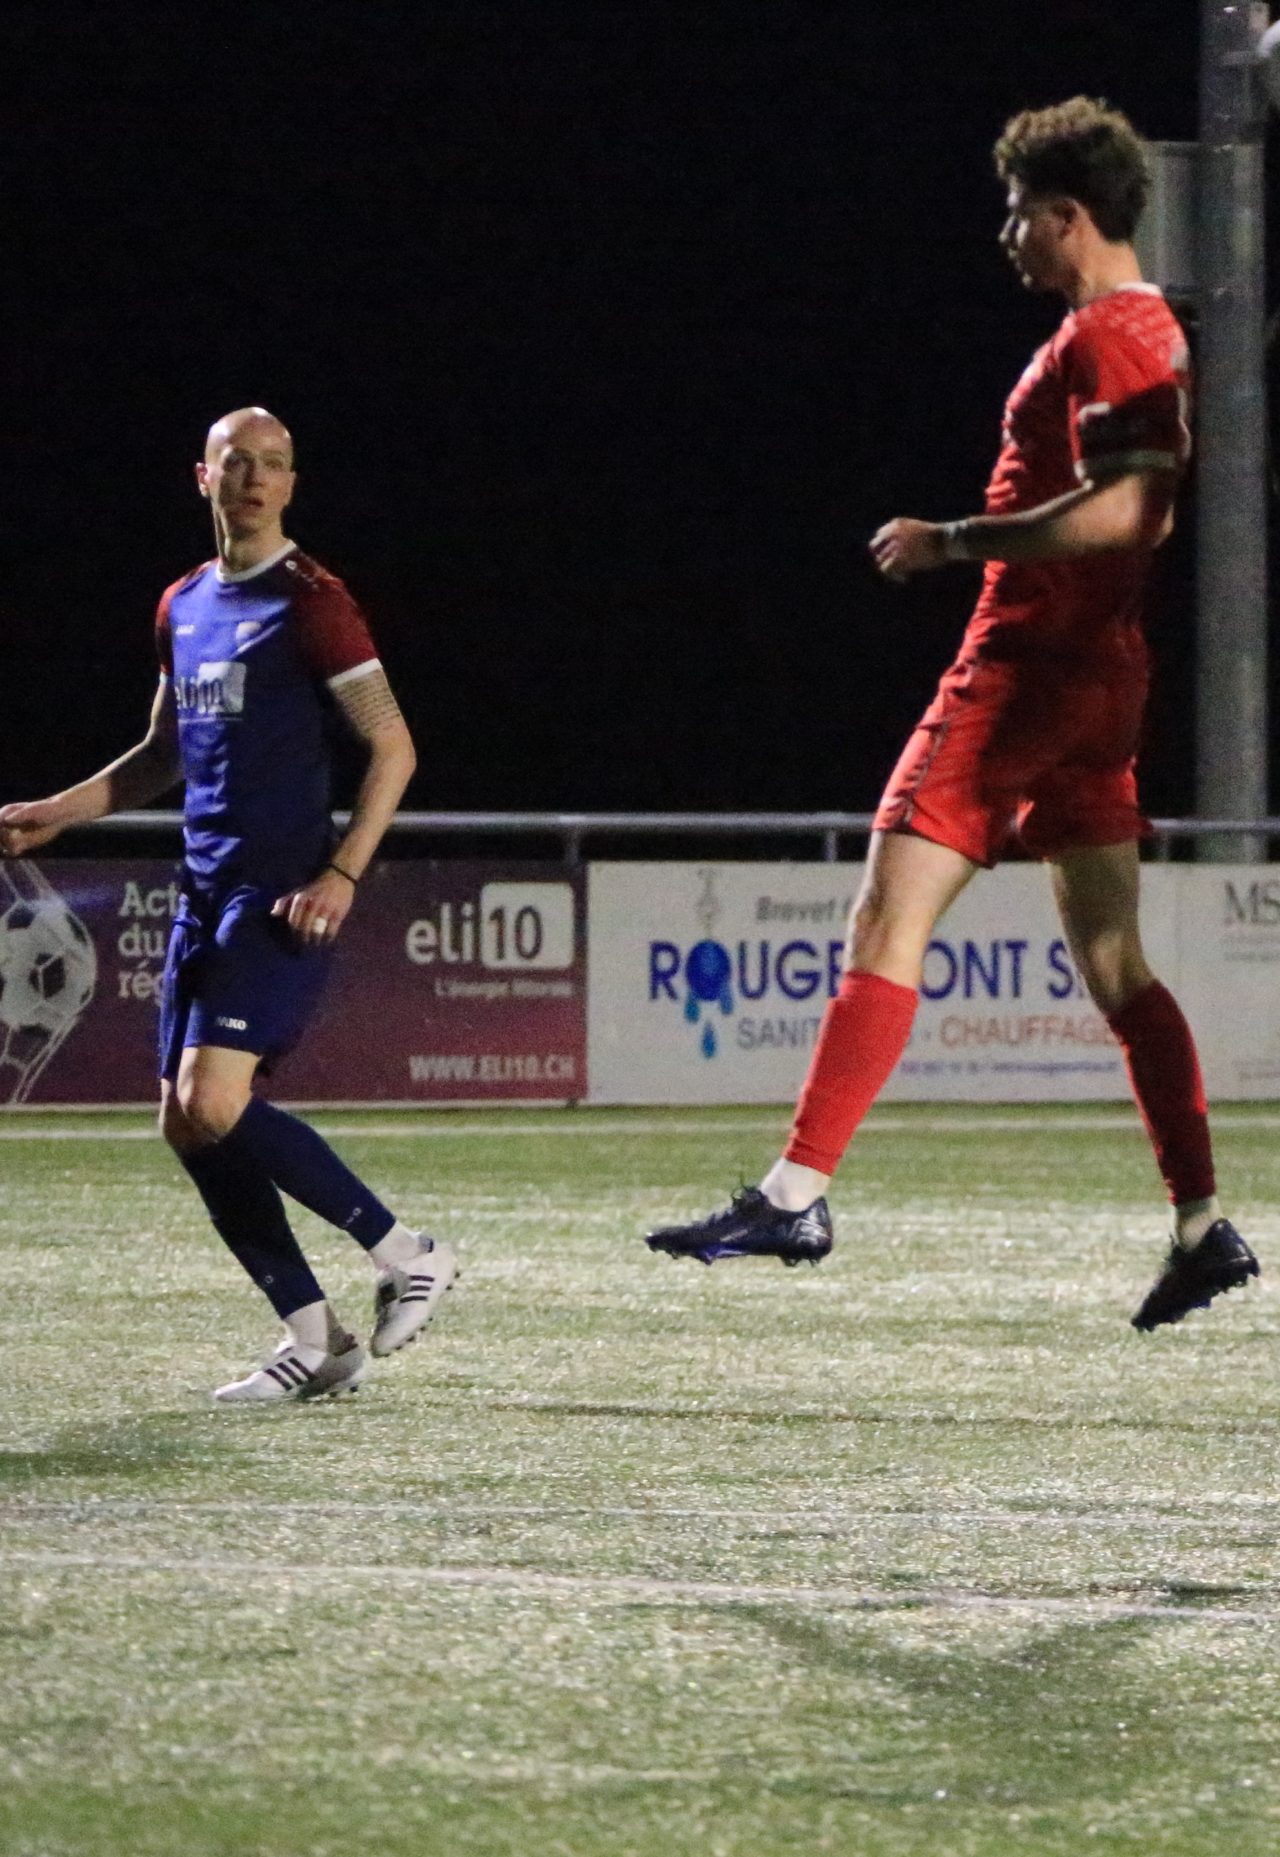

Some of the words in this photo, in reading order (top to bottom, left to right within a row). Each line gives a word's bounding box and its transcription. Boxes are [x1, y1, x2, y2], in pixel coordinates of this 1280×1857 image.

[118, 881, 180, 917] Act
[118, 920, 165, 957] du
[405, 902, 543, 966] eli10
[649, 937, 1027, 1001] ROUGEONT
